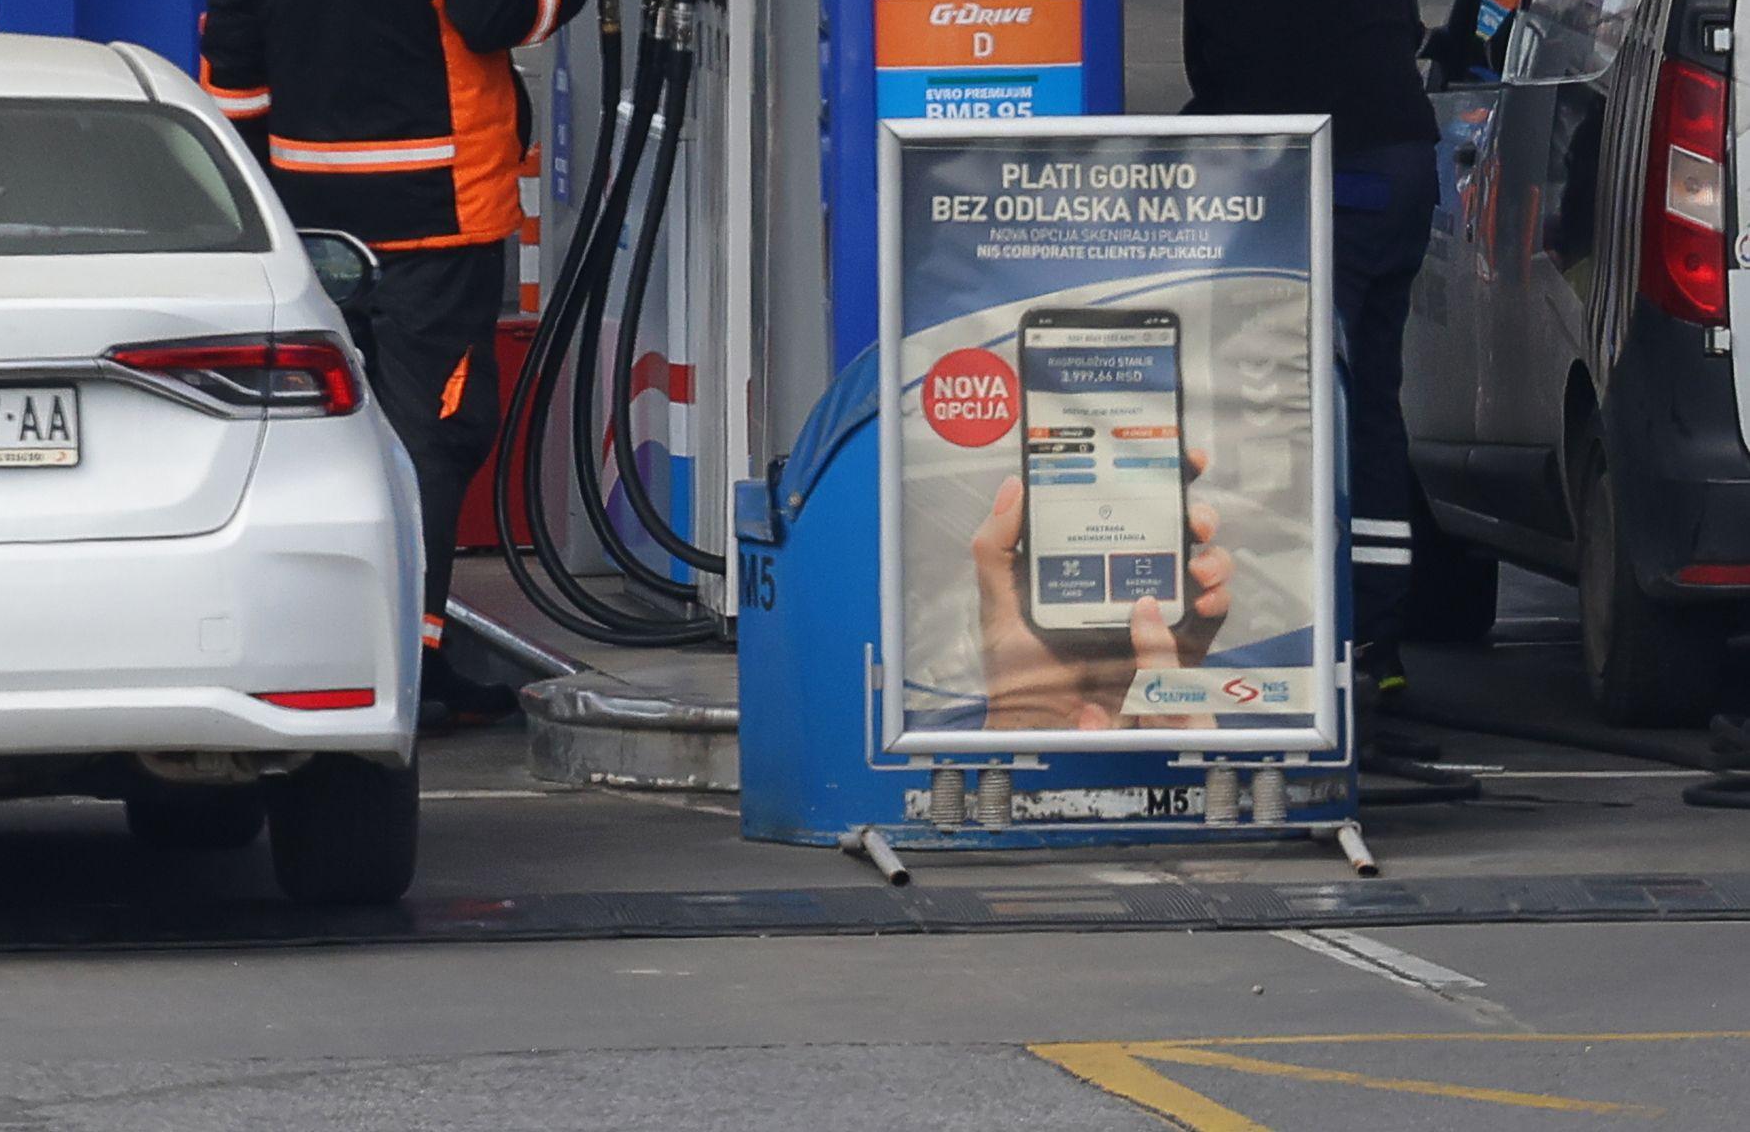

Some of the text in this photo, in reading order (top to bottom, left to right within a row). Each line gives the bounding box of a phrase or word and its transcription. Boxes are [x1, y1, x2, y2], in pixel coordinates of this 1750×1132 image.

[972, 32, 994, 57] D
[926, 88, 962, 100] EVRO
[997, 101, 1033, 118] 95
[1002, 164, 1197, 189] PLATI GORIVO
[931, 196, 1265, 222] BEZ ODLASKA NA KASU
[1030, 228, 1078, 242] OPCIJA
[1081, 228, 1149, 242] SKENIRAJ
[1002, 245, 1084, 259] CORPORATE
[1087, 245, 1146, 259] CLIENTS
[934, 375, 1009, 400] NOVA
[934, 401, 1010, 421] OPCIJA
[1149, 788, 1189, 815] M5
